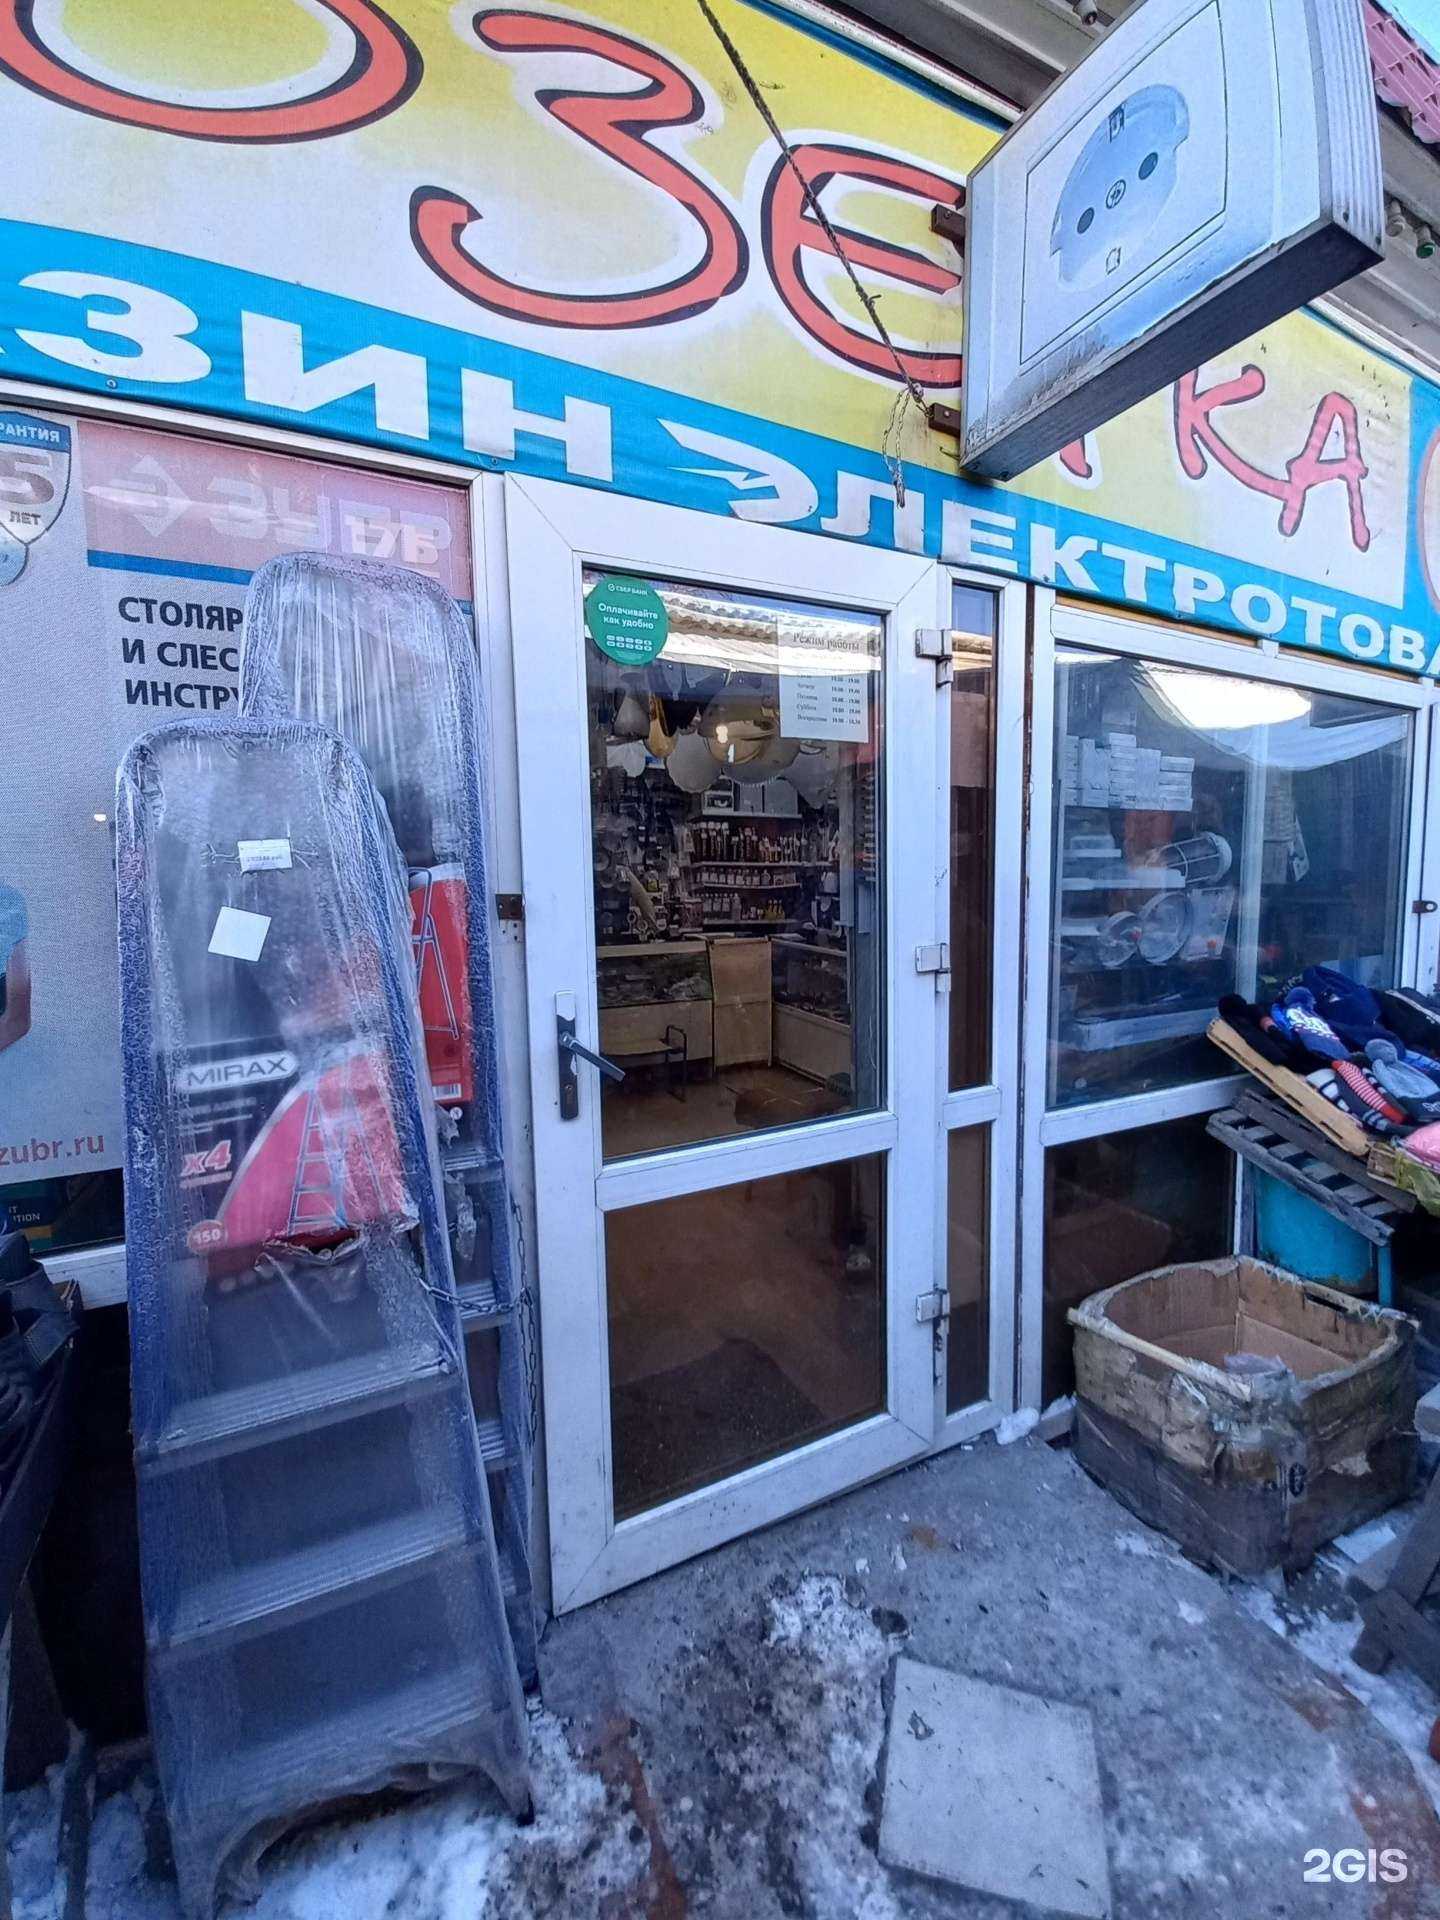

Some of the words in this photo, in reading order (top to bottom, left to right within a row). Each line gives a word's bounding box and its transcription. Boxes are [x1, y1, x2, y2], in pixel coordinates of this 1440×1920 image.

[0, 270, 613, 482] ЗИН
[10, 510, 41, 526] ЛЕТ
[118, 596, 243, 632] СТОЛЯР
[598, 602, 658, 619] Оплачивайте
[603, 616, 620, 625] как
[622, 619, 654, 630] удобно
[122, 637, 146, 665] И
[157, 641, 240, 672] СЛЕС
[793, 631, 824, 646] Режим
[827, 638, 860, 651] работы
[187, 1056, 288, 1088] MIRAX
[0, 1135, 104, 1166] zubr.ru
